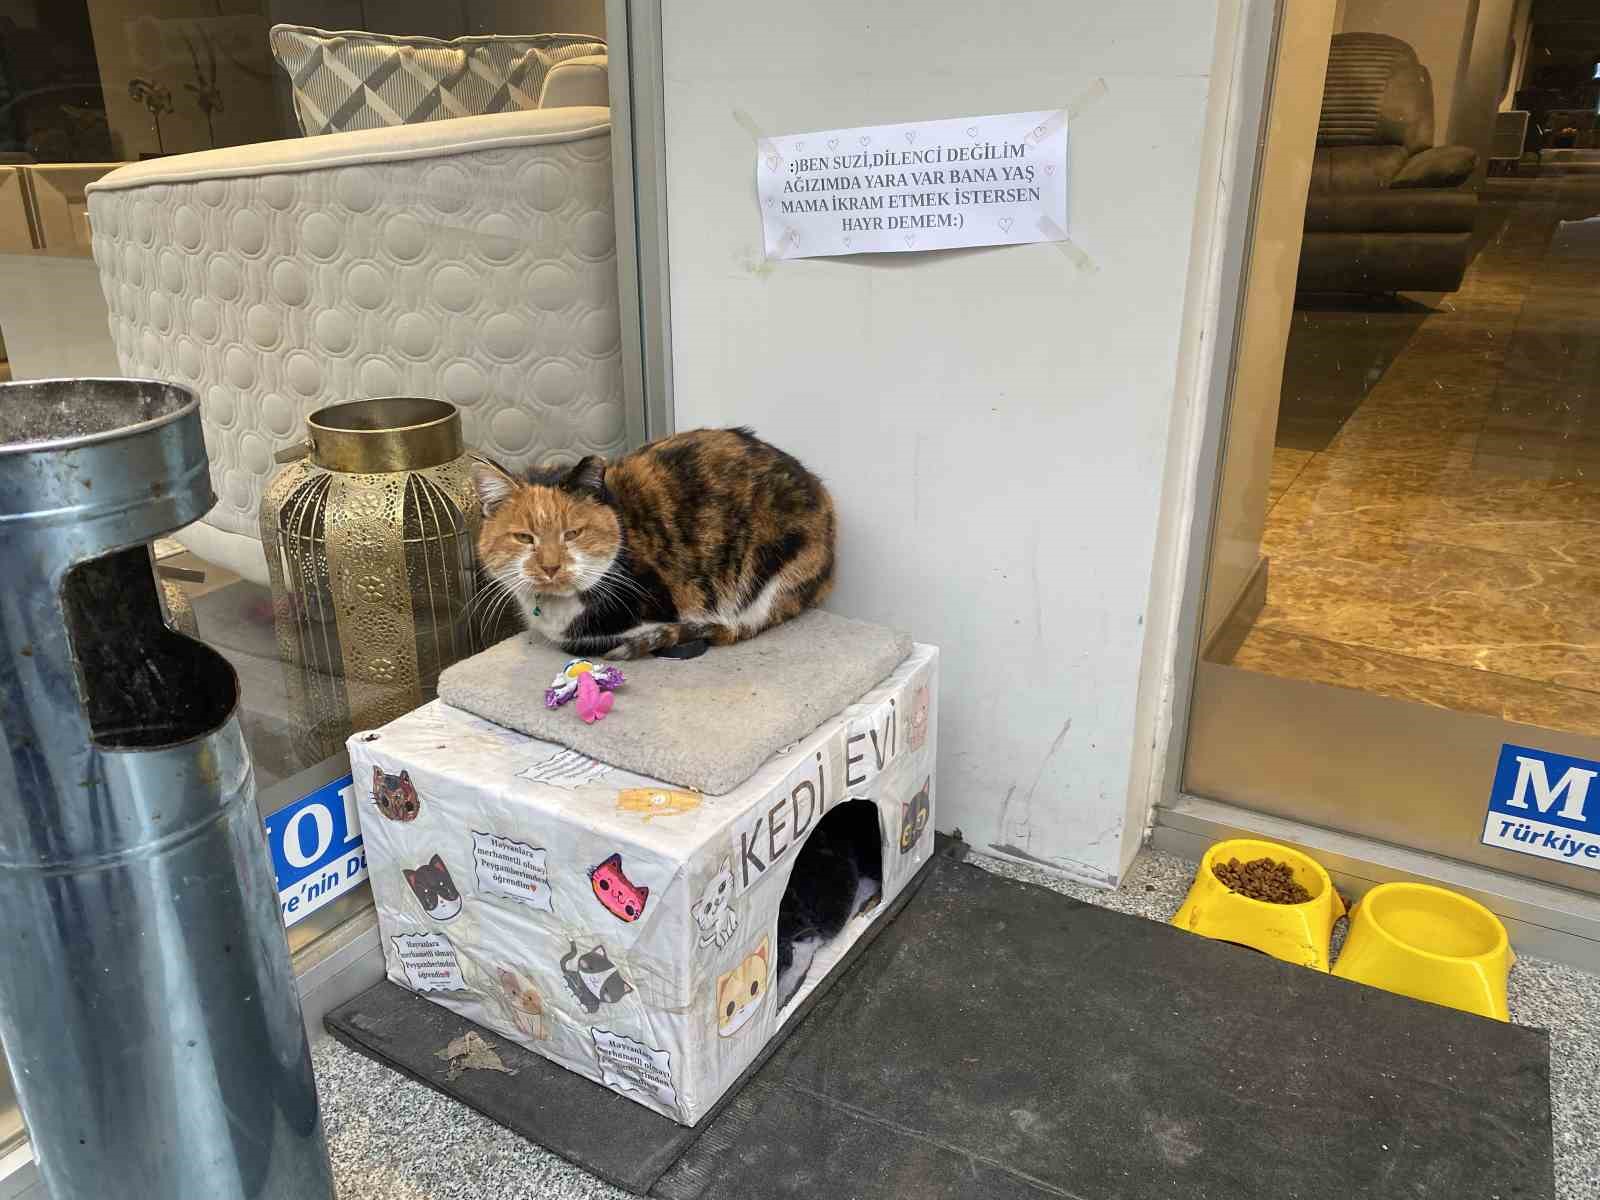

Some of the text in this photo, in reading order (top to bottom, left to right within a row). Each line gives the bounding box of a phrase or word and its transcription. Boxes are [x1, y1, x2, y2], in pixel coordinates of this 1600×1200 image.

[946, 141, 1025, 162] DEĞİLİM
[784, 164, 1035, 194] AĞIZIMDA YARA VAR BANA YAŞ
[781, 187, 1040, 214] MAMA İKRAM ETMEK İSTERSEN
[841, 212, 964, 232] HAYR DEMEM:)
[741, 752, 825, 888] KEDİ
[1499, 820, 1600, 858] Türkiye
